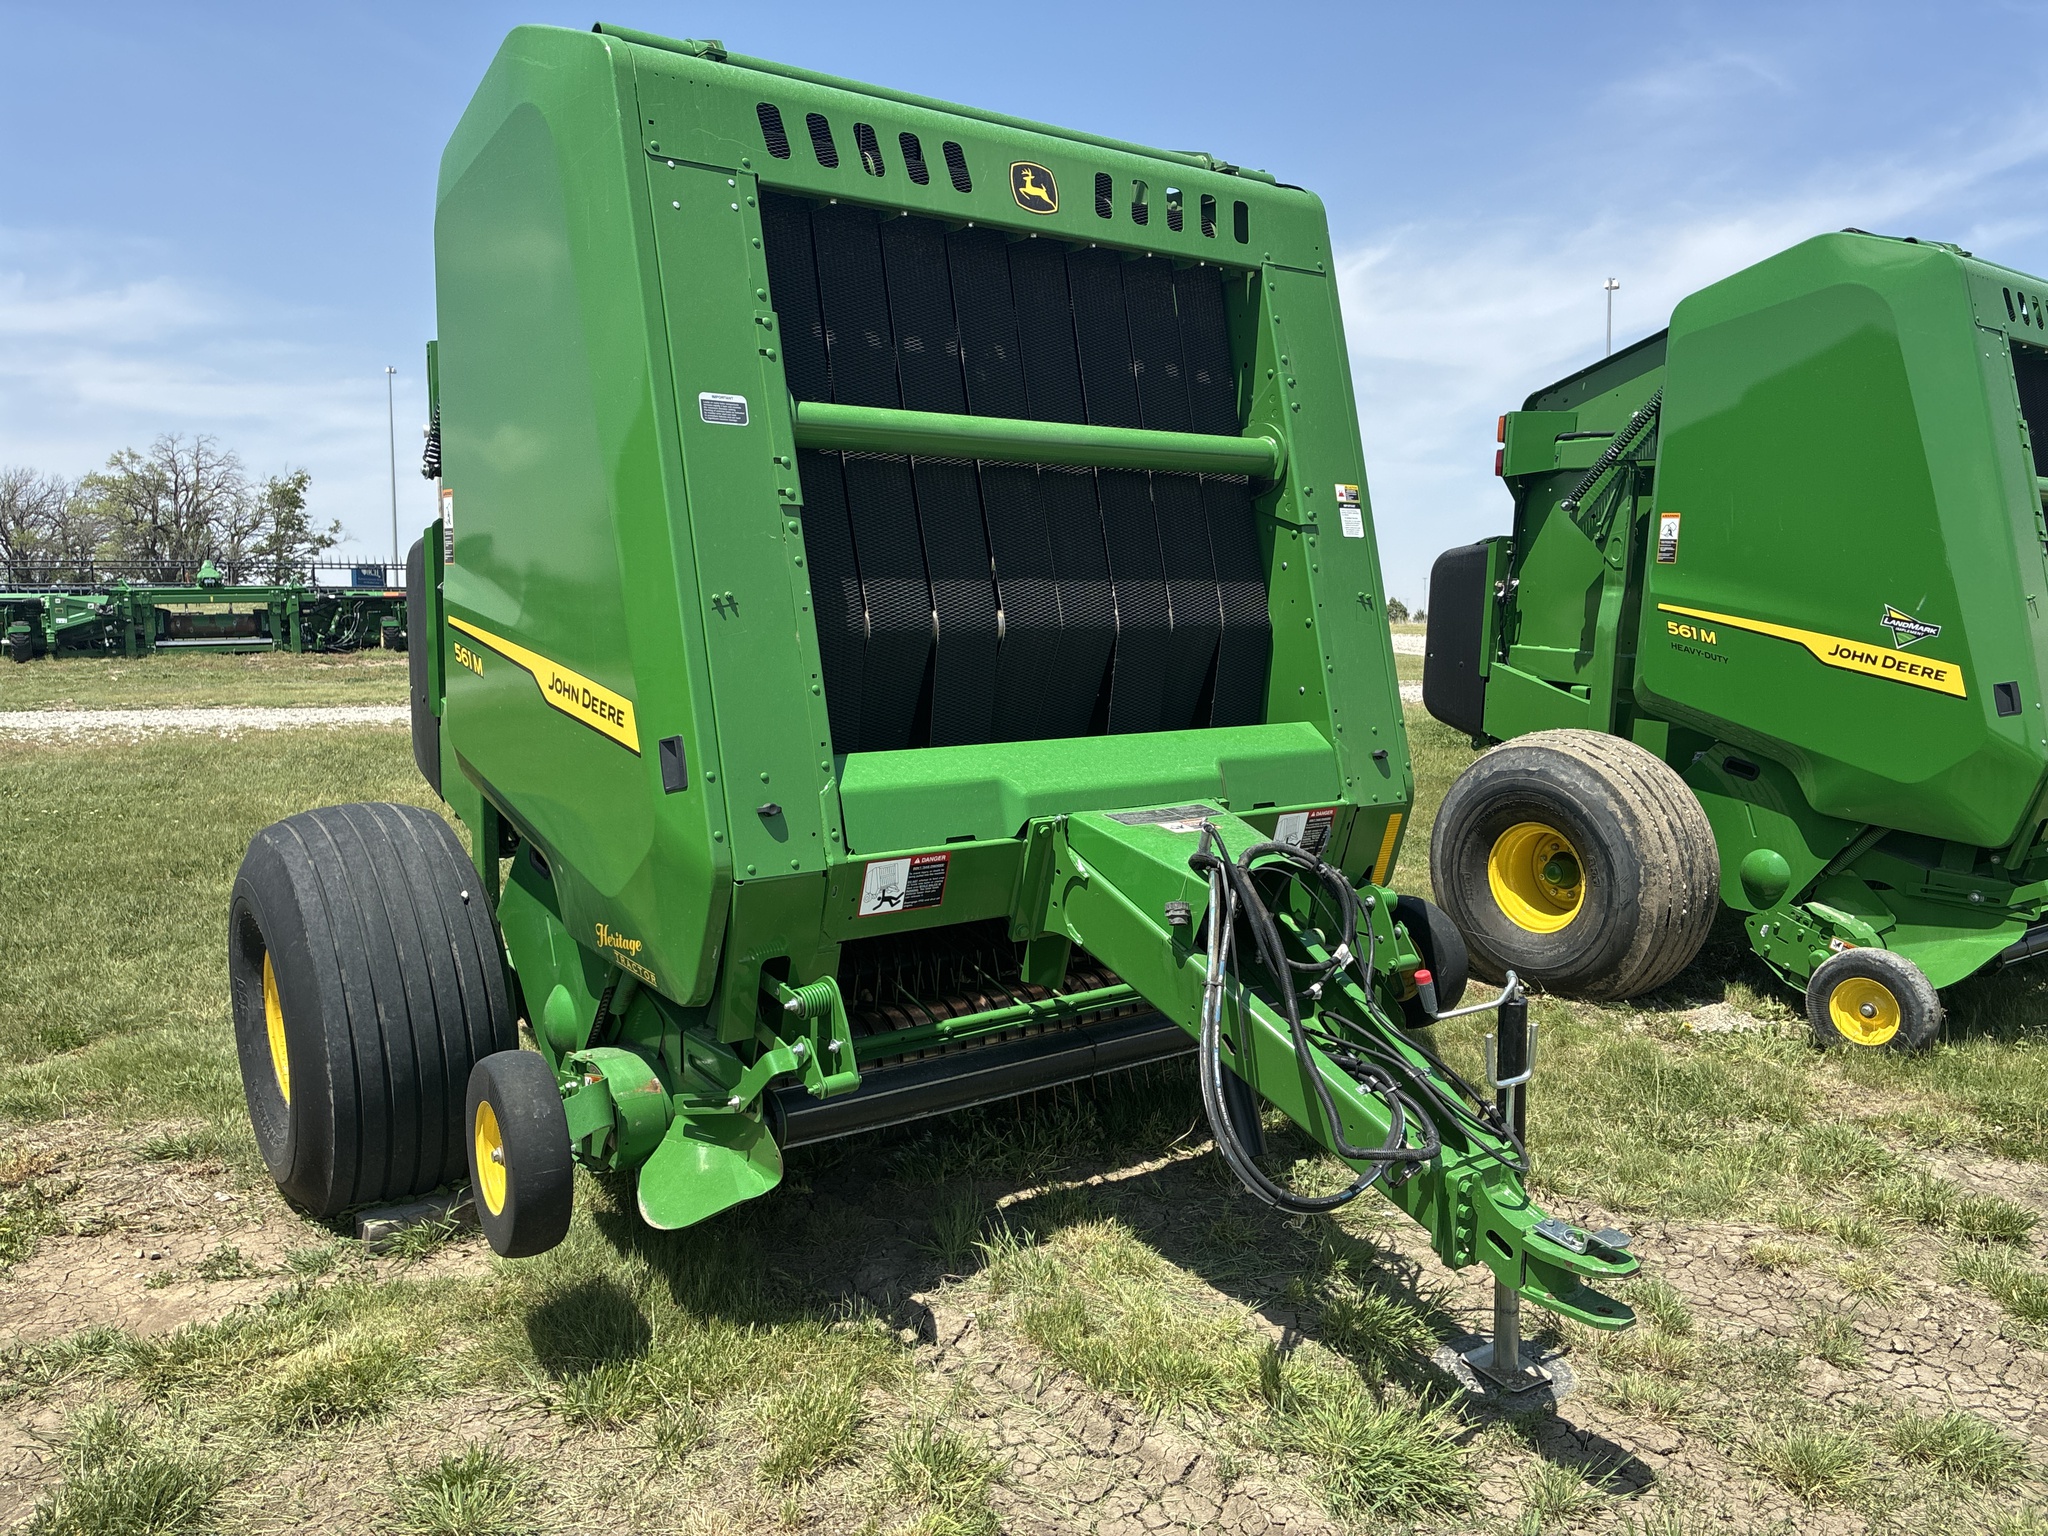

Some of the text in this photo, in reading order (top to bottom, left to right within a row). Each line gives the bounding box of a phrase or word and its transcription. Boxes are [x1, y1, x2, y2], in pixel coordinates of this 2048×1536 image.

[1883, 617, 1938, 635] LANDMARK
[1671, 642, 1729, 664] HEAVY-DUTY
[1828, 643, 1947, 683] JOHN DEERE
[548, 672, 625, 728] JOHN DEERE
[921, 855, 946, 863] DANGER
[595, 922, 643, 957] Heritage
[614, 951, 657, 985] TRACTOR
